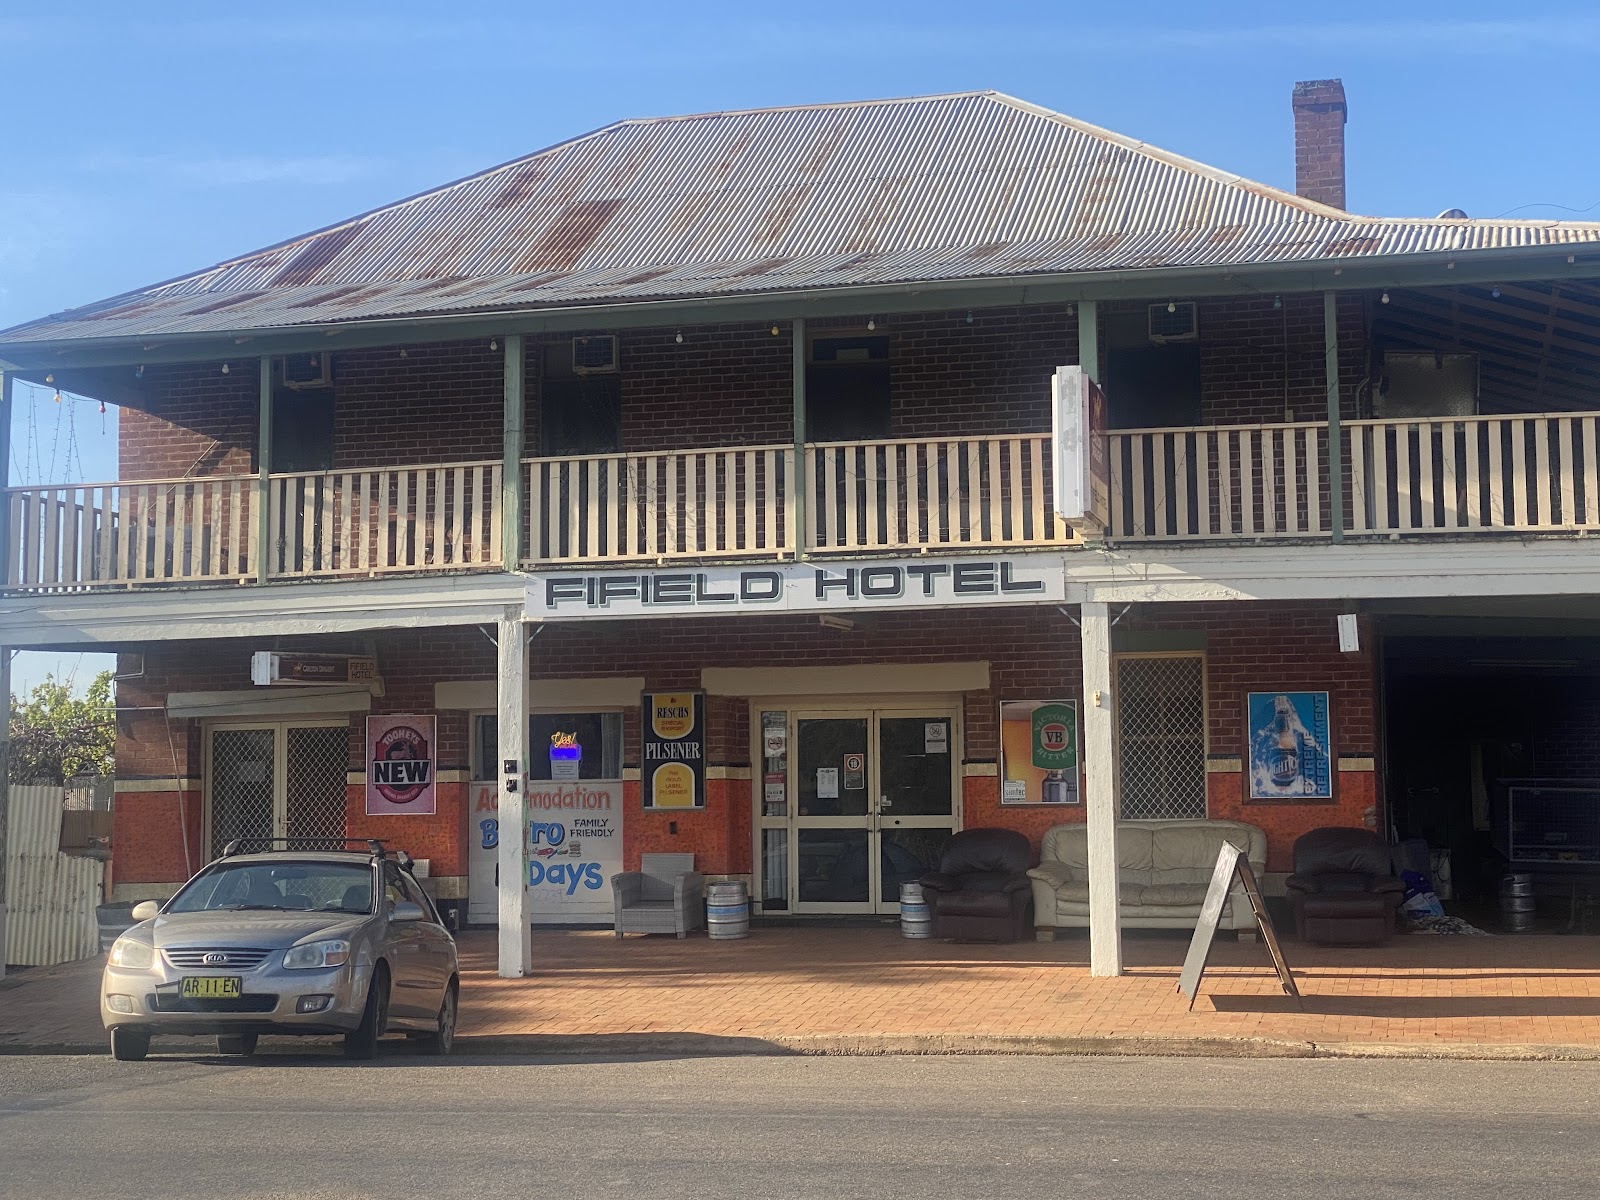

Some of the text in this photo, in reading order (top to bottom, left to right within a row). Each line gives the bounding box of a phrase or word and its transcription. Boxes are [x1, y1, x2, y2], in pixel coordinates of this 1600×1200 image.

[546, 562, 1046, 608] FIFIELD HOTEL
[350, 663, 374, 671] FIFIELD
[351, 671, 373, 679] HOTEL
[657, 706, 689, 719] RESCHS
[1034, 714, 1075, 731] VICTORIA
[382, 729, 421, 746] TOOHEYS
[551, 731, 577, 748] Yes!
[1045, 731, 1063, 743] VB
[1313, 694, 1327, 794] REFRESHMENT
[645, 742, 701, 760] PILSENER
[1037, 746, 1075, 760] BITTER
[1303, 731, 1314, 794] EXTREME
[374, 761, 430, 783] NEW
[574, 818, 609, 828] FAMILY
[480, 818, 565, 849] Bro
[570, 828, 615, 838] FRIENDLY
[530, 861, 603, 896] Days
